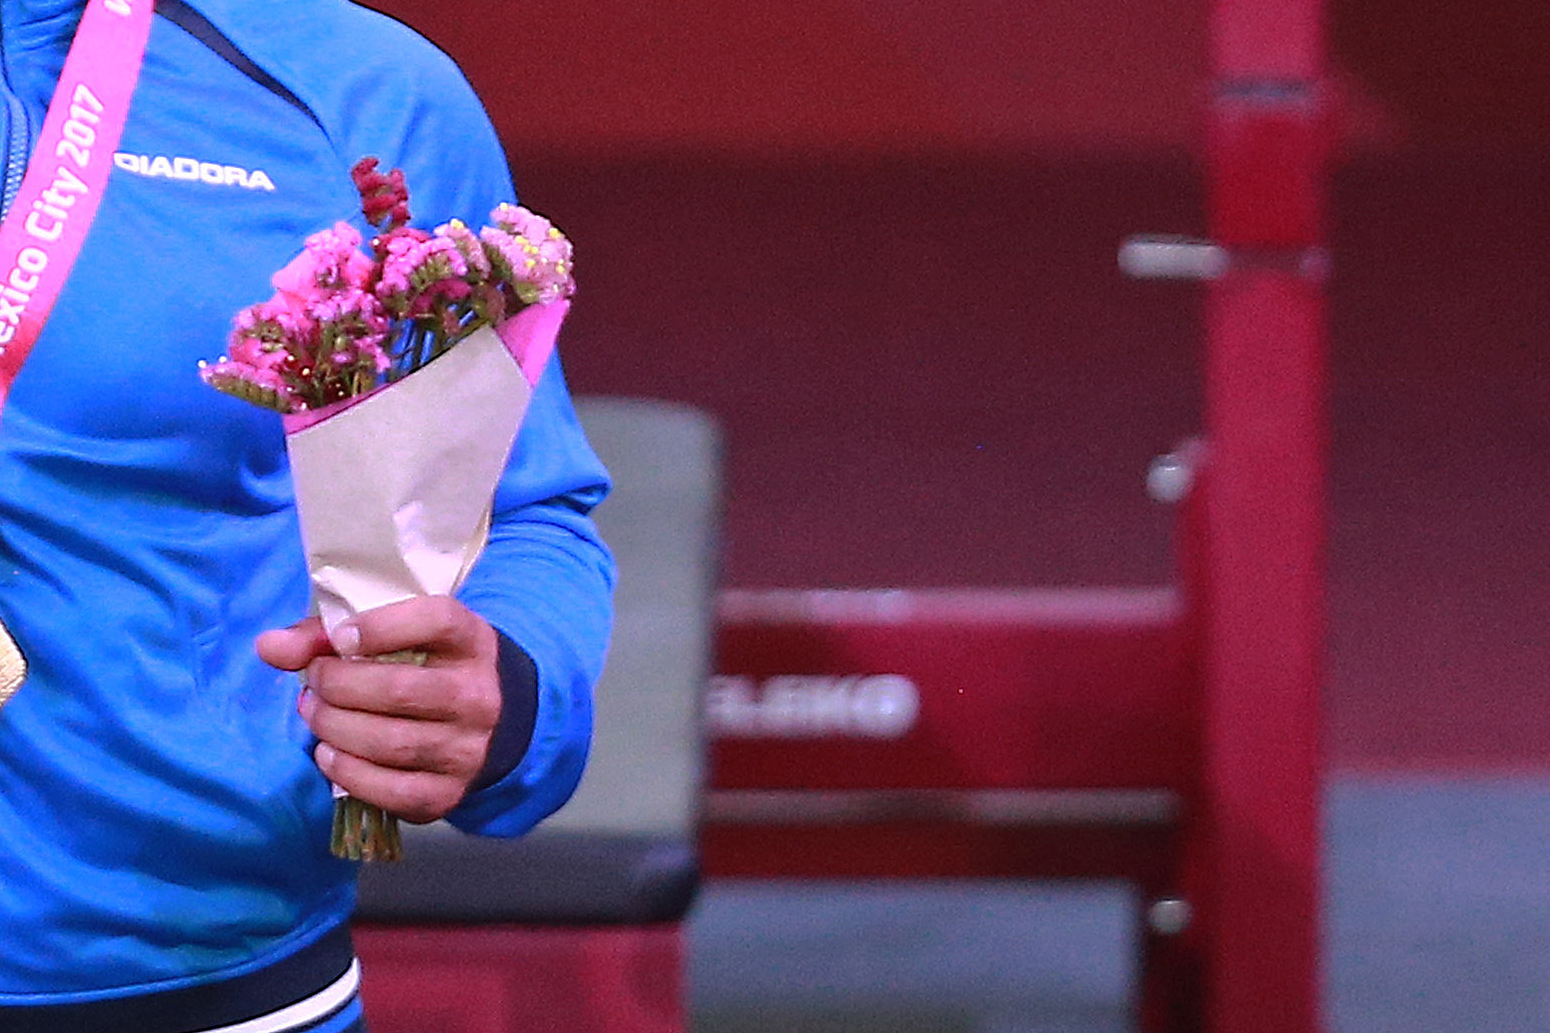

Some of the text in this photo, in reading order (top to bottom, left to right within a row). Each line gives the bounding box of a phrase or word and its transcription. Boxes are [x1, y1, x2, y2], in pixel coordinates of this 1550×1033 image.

[56, 82, 106, 168] 2017
[23, 166, 90, 243] City
[112, 151, 277, 192] DIADORA
